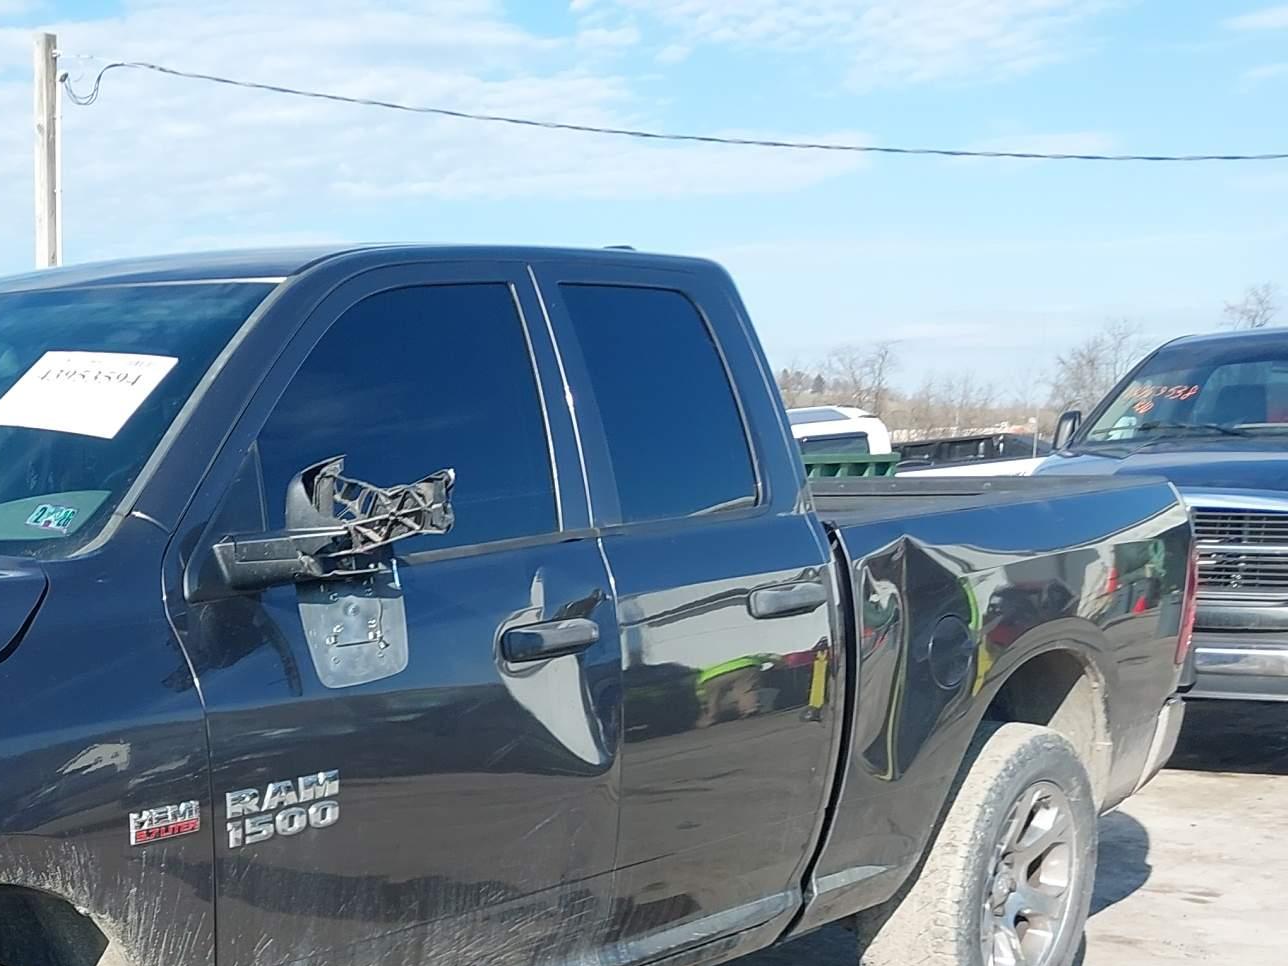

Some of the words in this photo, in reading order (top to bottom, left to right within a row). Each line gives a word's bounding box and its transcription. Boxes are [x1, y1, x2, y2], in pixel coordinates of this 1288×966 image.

[225, 769, 340, 820] RAM
[129, 800, 200, 831] HEMI
[160, 818, 198, 837] LITER
[226, 799, 340, 849] 1500
